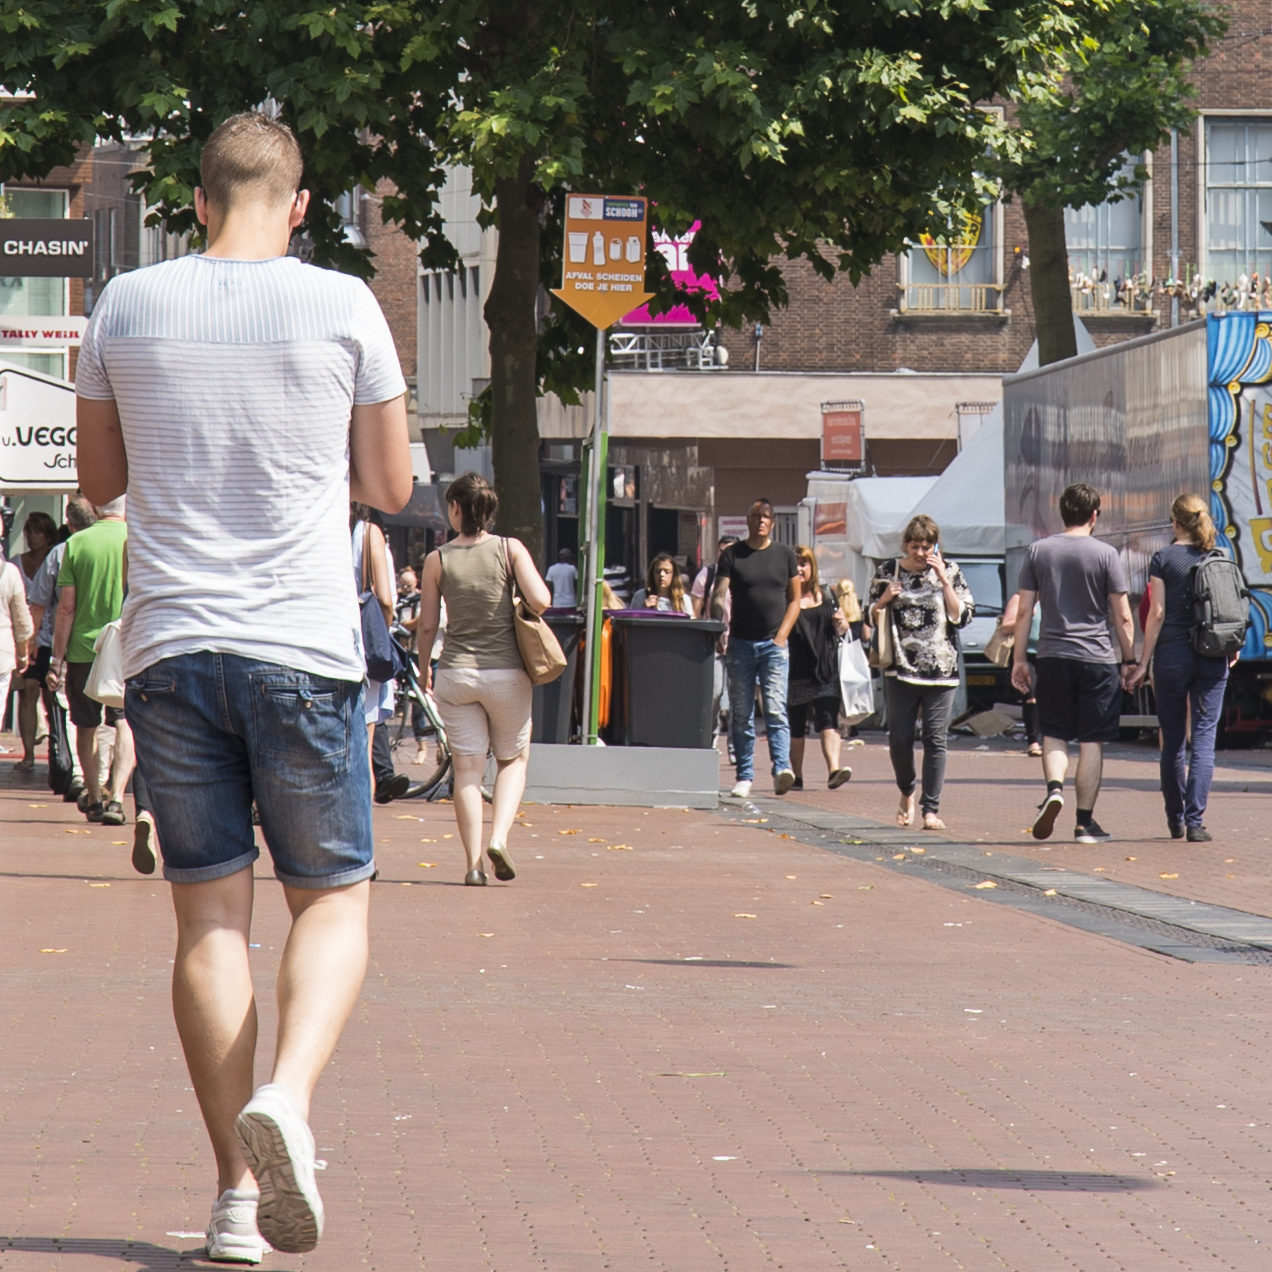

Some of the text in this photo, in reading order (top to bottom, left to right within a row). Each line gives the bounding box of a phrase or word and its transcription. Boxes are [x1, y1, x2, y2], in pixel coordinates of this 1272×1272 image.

[3, 239, 89, 256] CHASIN'
[566, 272, 642, 282] AFVAL SCHEIDEN
[575, 282, 632, 292] DOE JE HIER
[1, 330, 38, 338] TALLY
